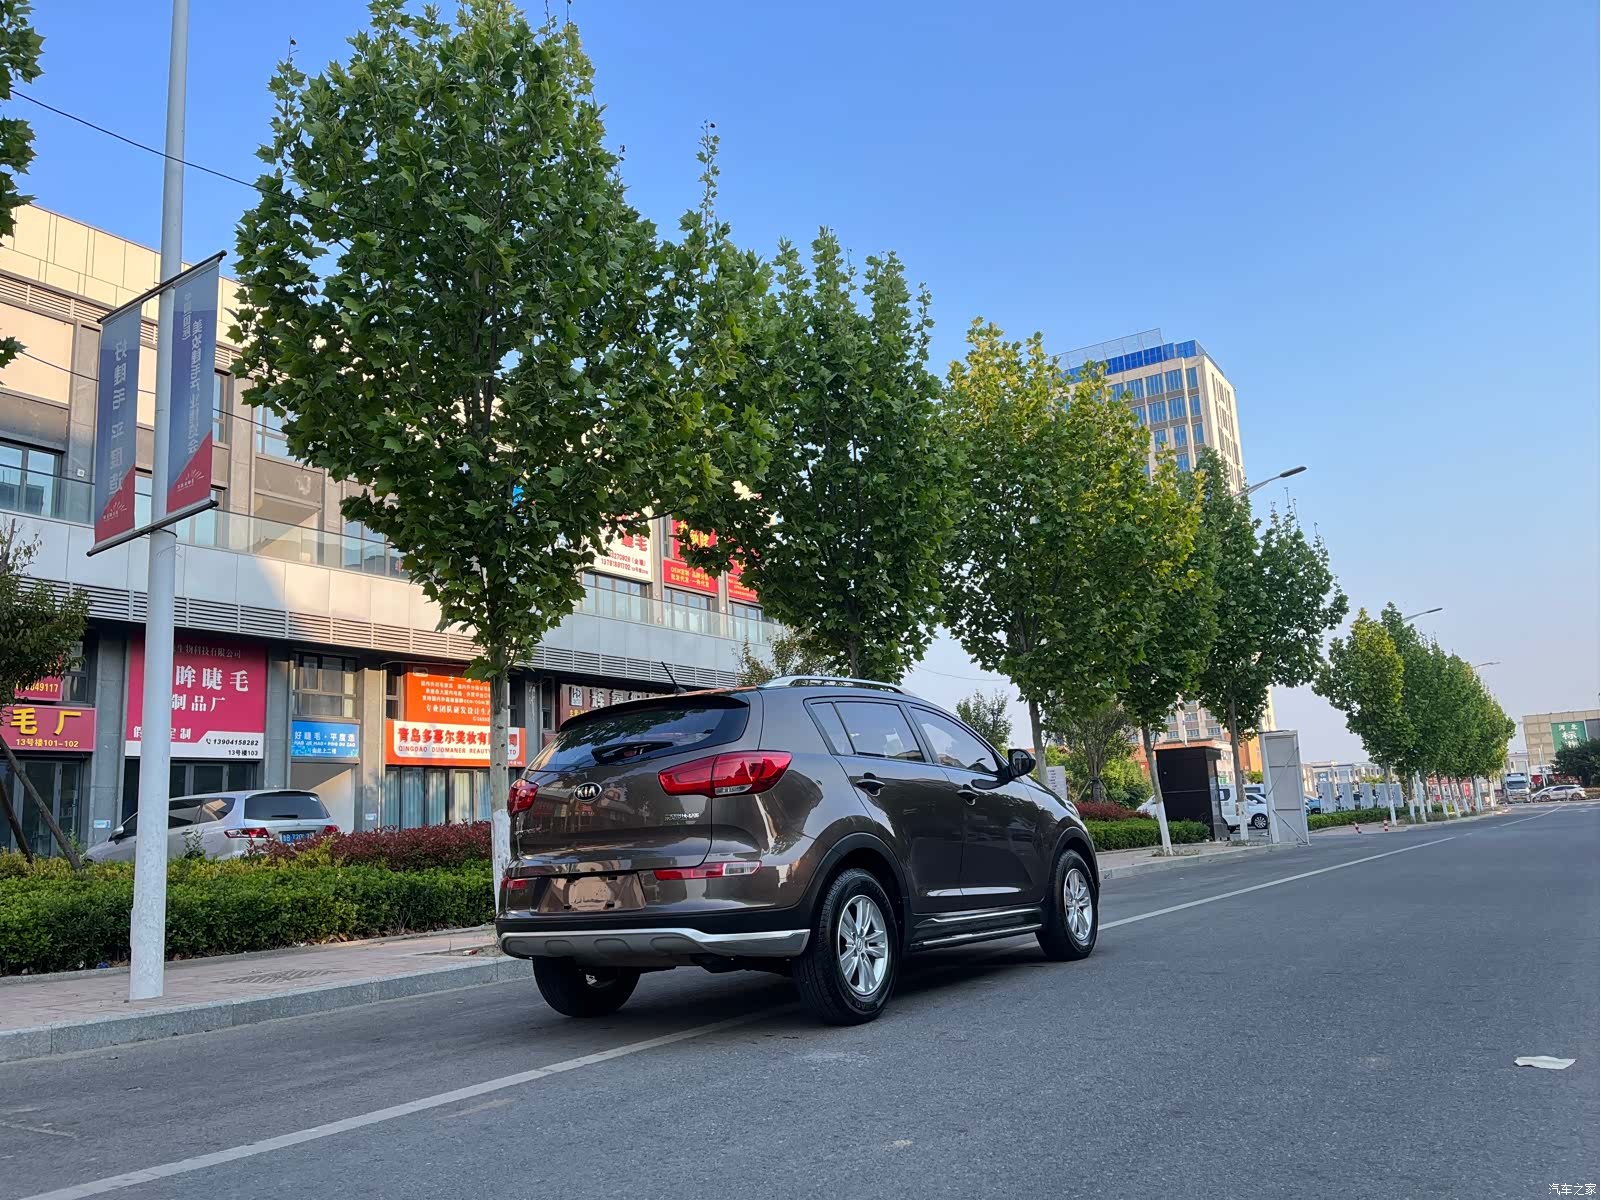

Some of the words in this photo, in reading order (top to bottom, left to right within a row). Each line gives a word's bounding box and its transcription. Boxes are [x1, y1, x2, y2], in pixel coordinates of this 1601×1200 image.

[175, 644, 241, 659] 生物科技有限公司
[16, 738, 79, 748] 13号楼101-102
[213, 738, 259, 746] 13904158282
[398, 745, 428, 753] QINGDAO
[577, 786, 597, 798] KIA
